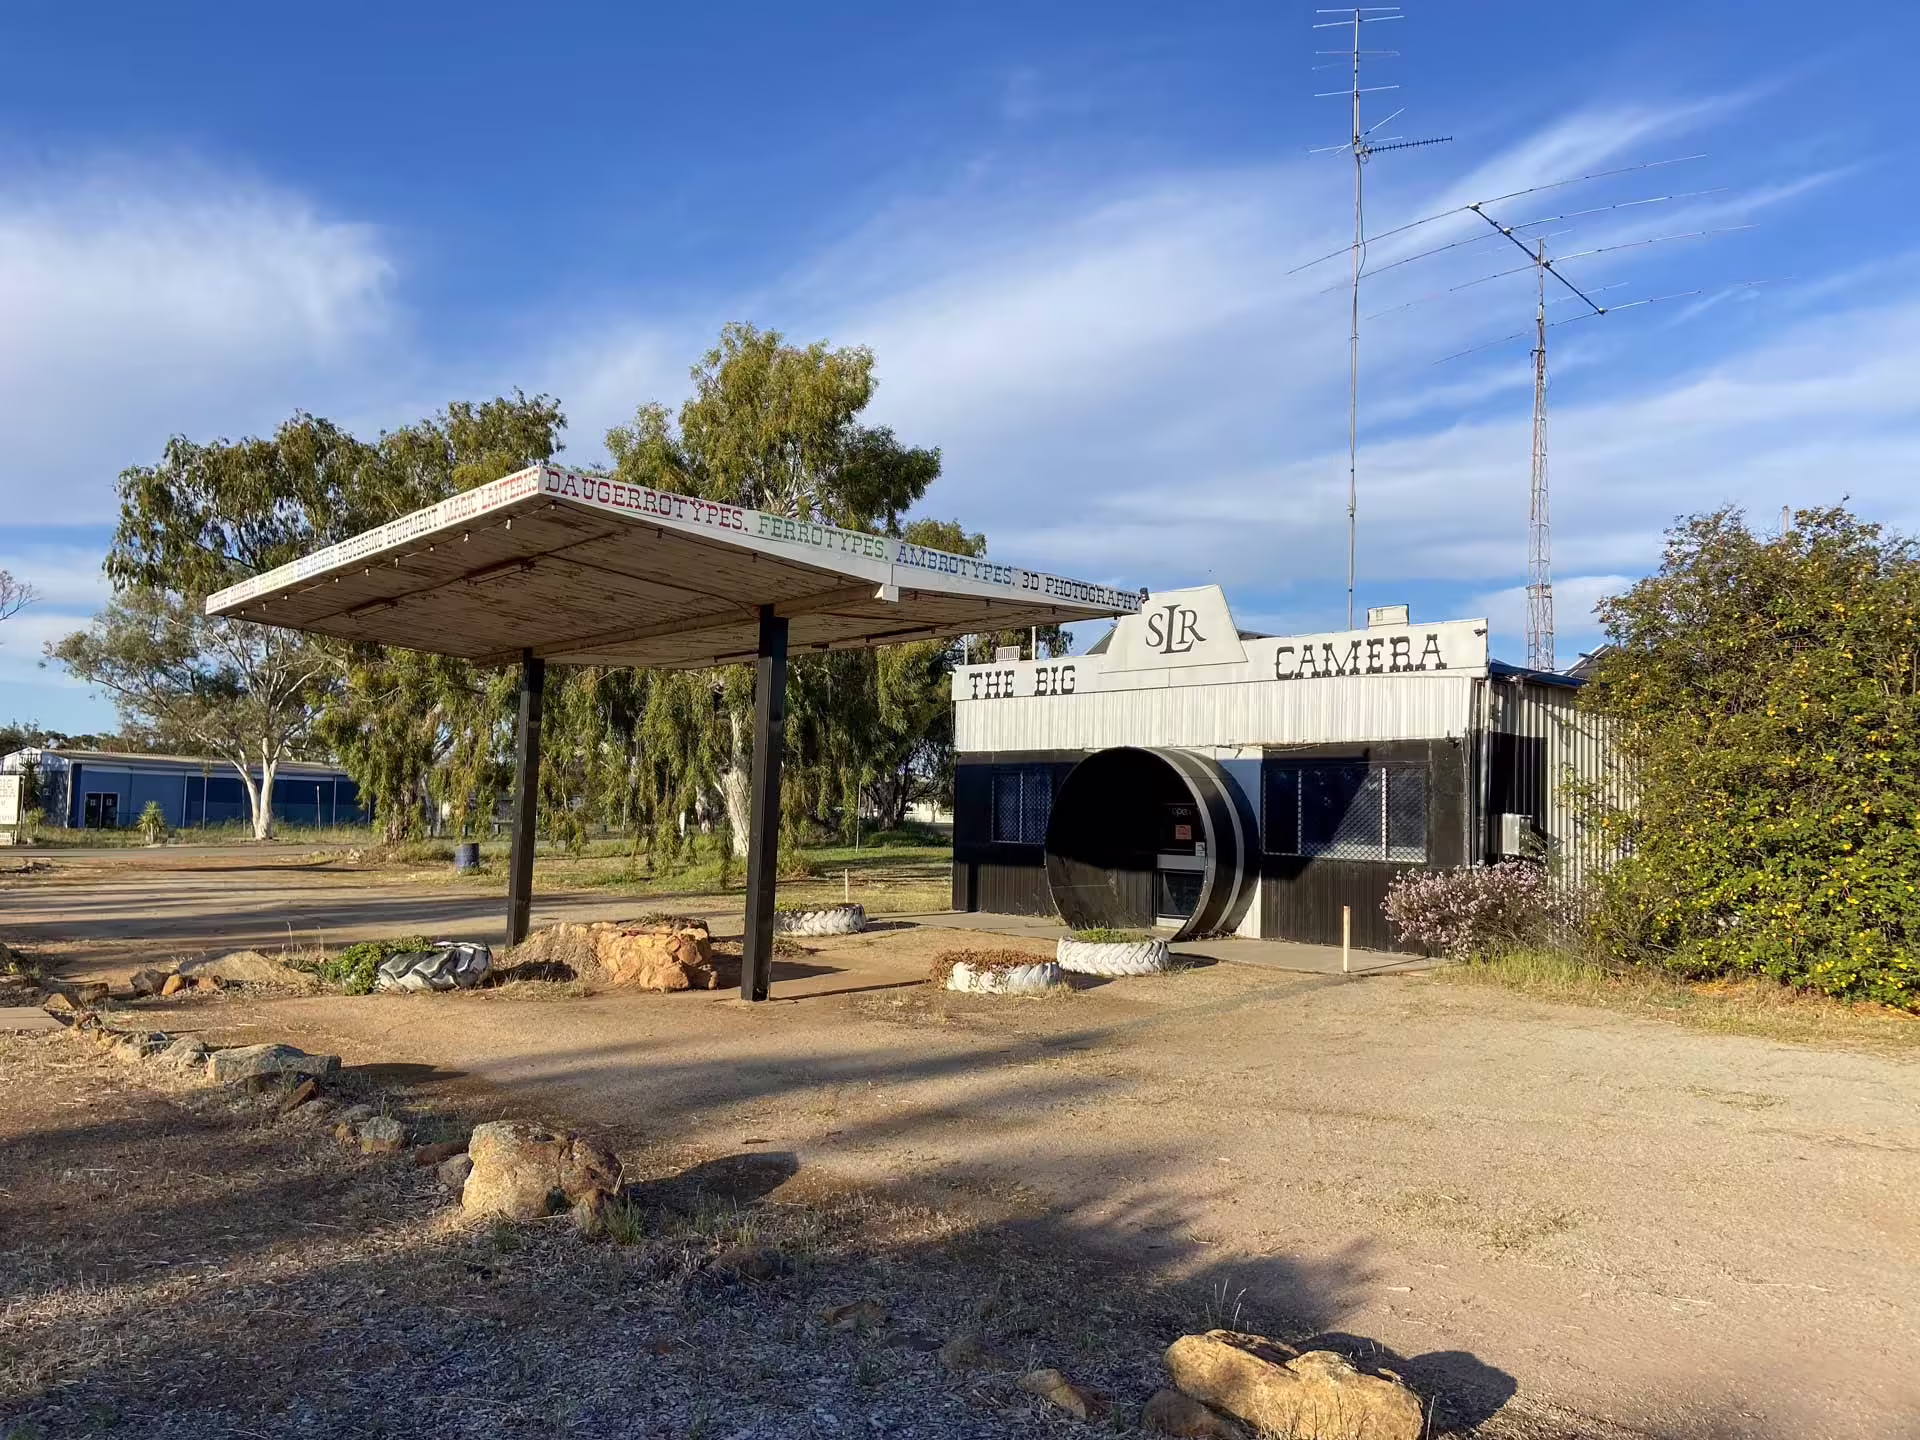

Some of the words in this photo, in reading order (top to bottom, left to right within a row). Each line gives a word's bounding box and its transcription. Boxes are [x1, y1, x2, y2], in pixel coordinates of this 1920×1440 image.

[444, 493, 477, 523] MAGIC
[480, 469, 538, 510] LANTERNS
[545, 470, 748, 532] DAUGERROTYPES.
[758, 514, 888, 561] FERROTYPES.
[896, 544, 1015, 587] AMBROTYPES.
[1022, 571, 1039, 590] 3D
[1045, 576, 1141, 612] PHOTOGRAPHY
[1146, 604, 1207, 655] SLR
[969, 670, 1015, 699] THE
[1034, 665, 1075, 696] BIG
[1274, 633, 1447, 680] CAMERA
